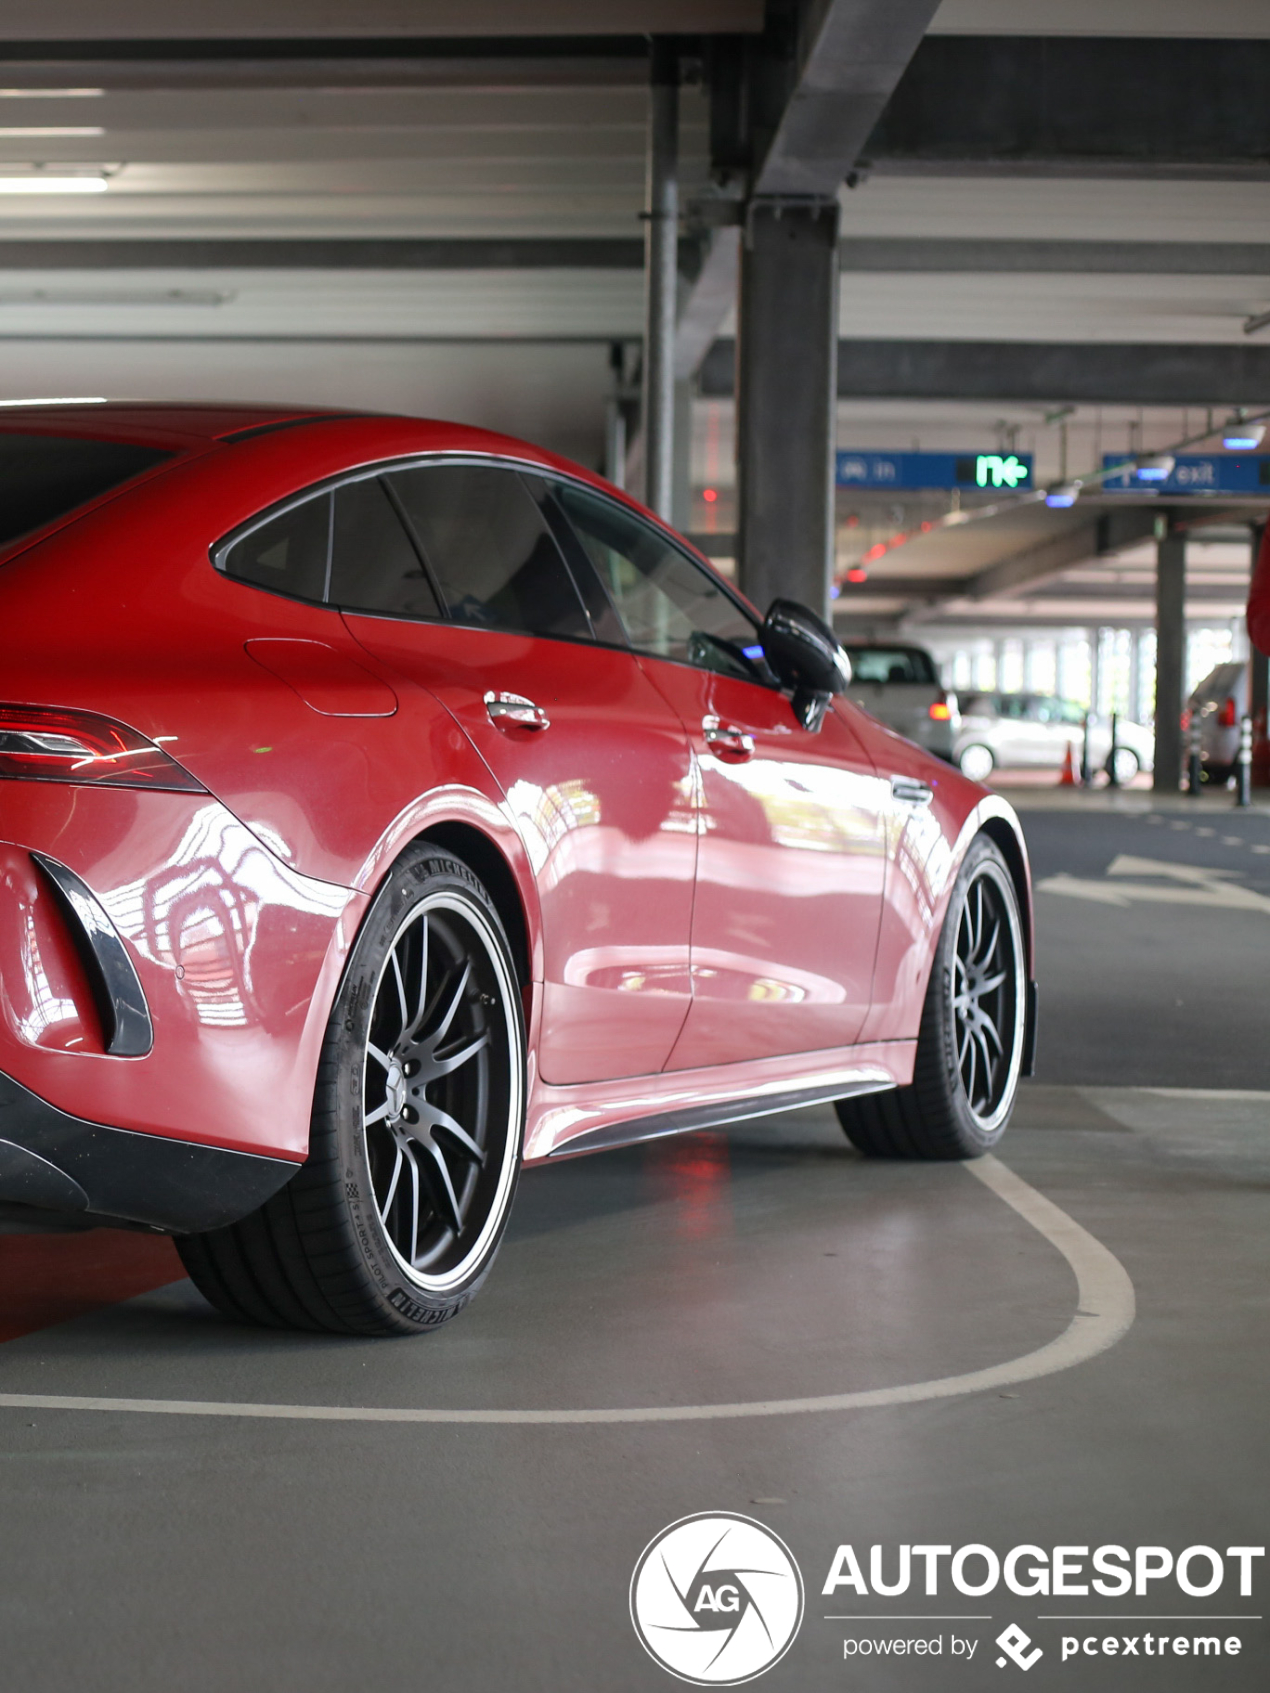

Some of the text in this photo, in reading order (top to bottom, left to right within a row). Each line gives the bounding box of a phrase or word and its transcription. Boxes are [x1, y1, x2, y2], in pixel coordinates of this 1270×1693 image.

[1176, 460, 1215, 485] exit
[356, 1222, 375, 1260] SPORT
[371, 1263, 389, 1289] PILOT
[390, 1291, 458, 1324] MICHELIN
